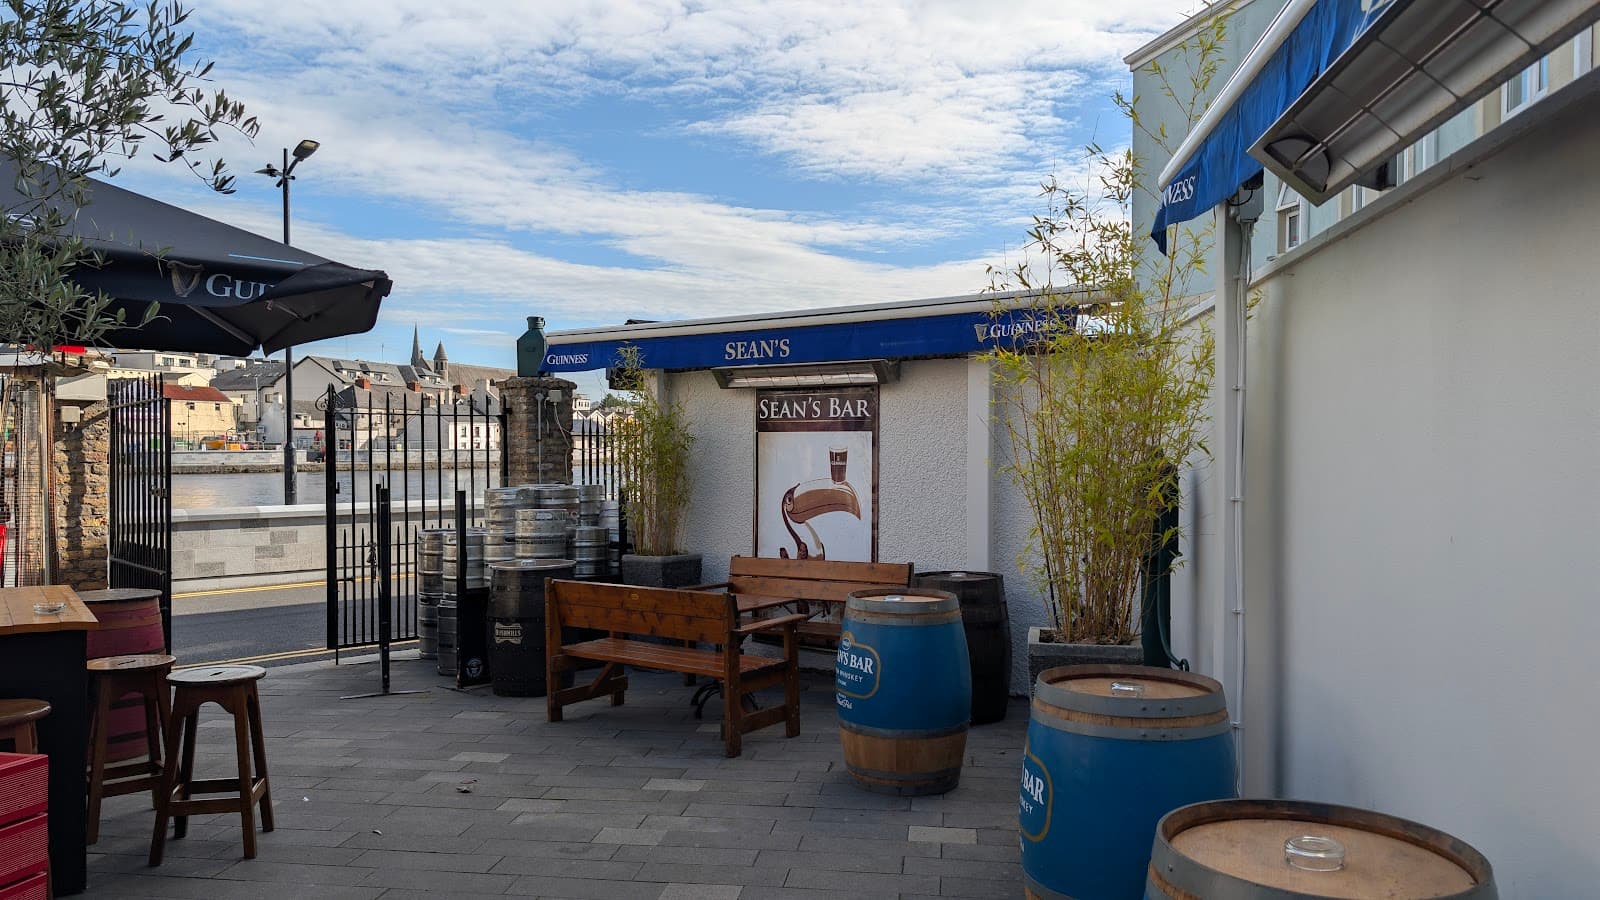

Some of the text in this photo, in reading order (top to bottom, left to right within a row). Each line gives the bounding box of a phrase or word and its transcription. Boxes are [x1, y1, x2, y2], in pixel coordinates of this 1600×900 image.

[206, 273, 274, 299] GUI
[546, 353, 589, 365] GUINNESS
[725, 339, 790, 360] SEAN'S
[759, 397, 871, 419] SEAN'S BAR
[849, 654, 873, 674] BAR
[1023, 768, 1044, 805] BAR
